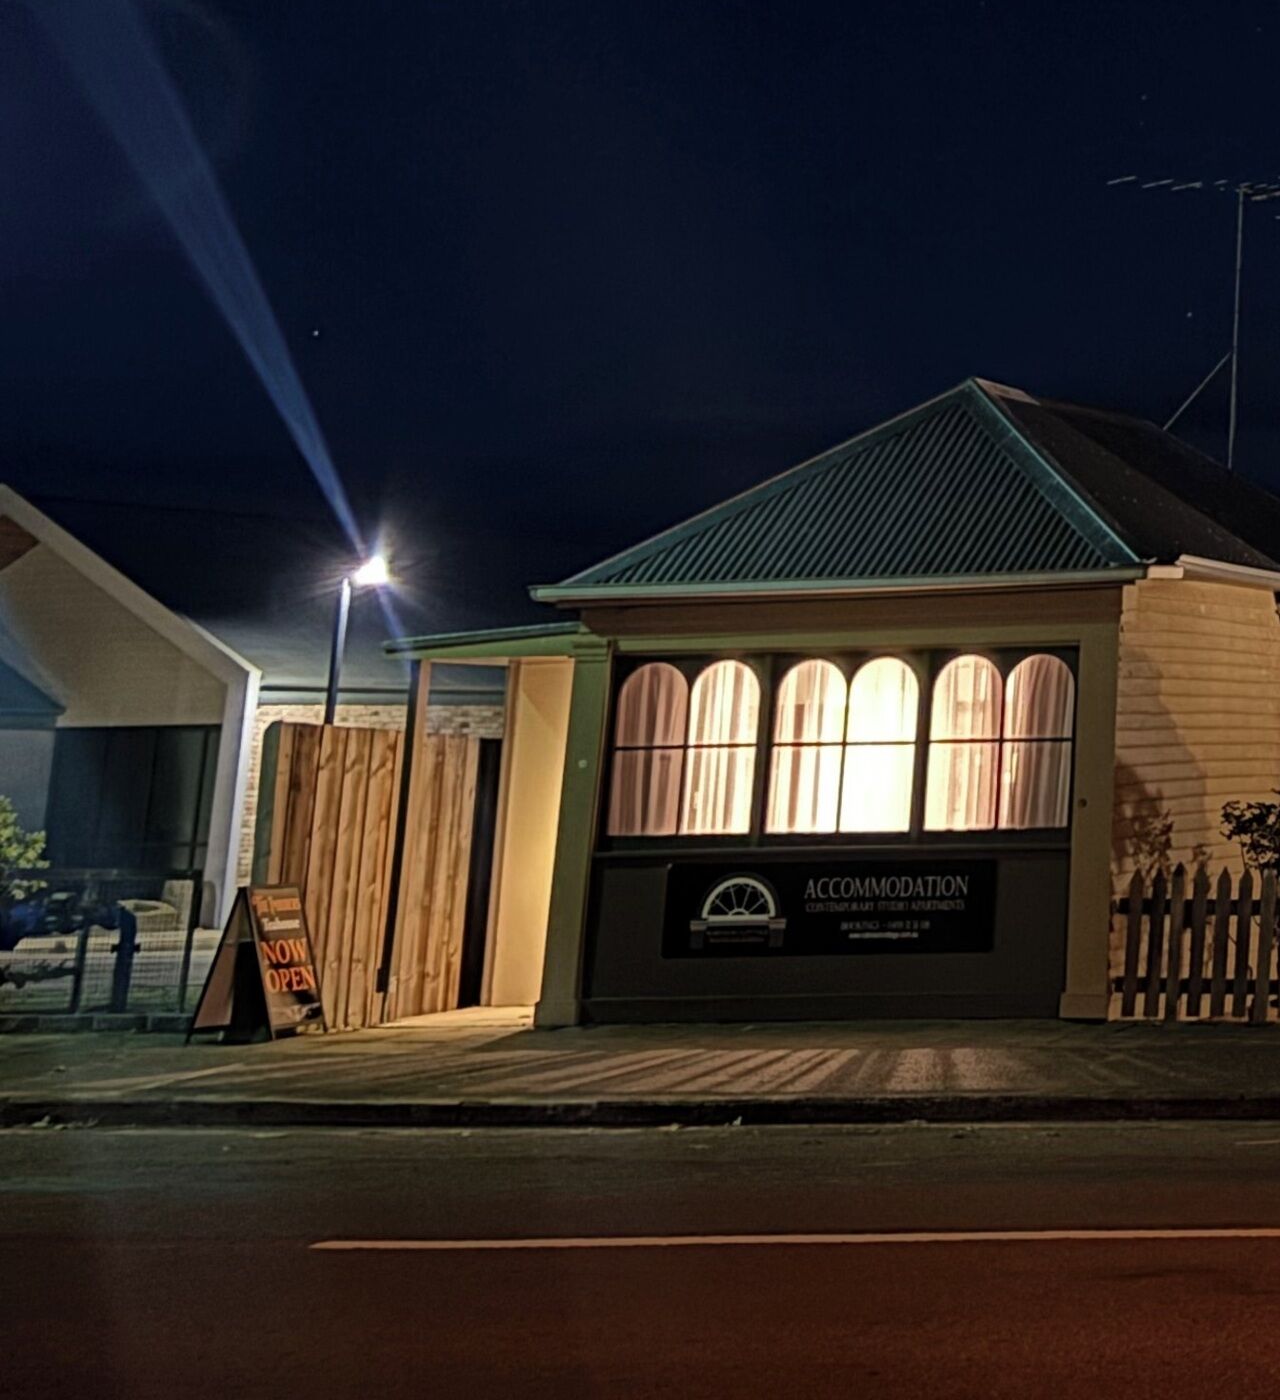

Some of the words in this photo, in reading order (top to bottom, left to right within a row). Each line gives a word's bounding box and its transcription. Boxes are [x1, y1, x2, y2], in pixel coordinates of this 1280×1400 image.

[804, 875, 969, 899] ACCOMMODATION
[261, 938, 307, 964] NOW
[265, 965, 316, 993] OPEN
